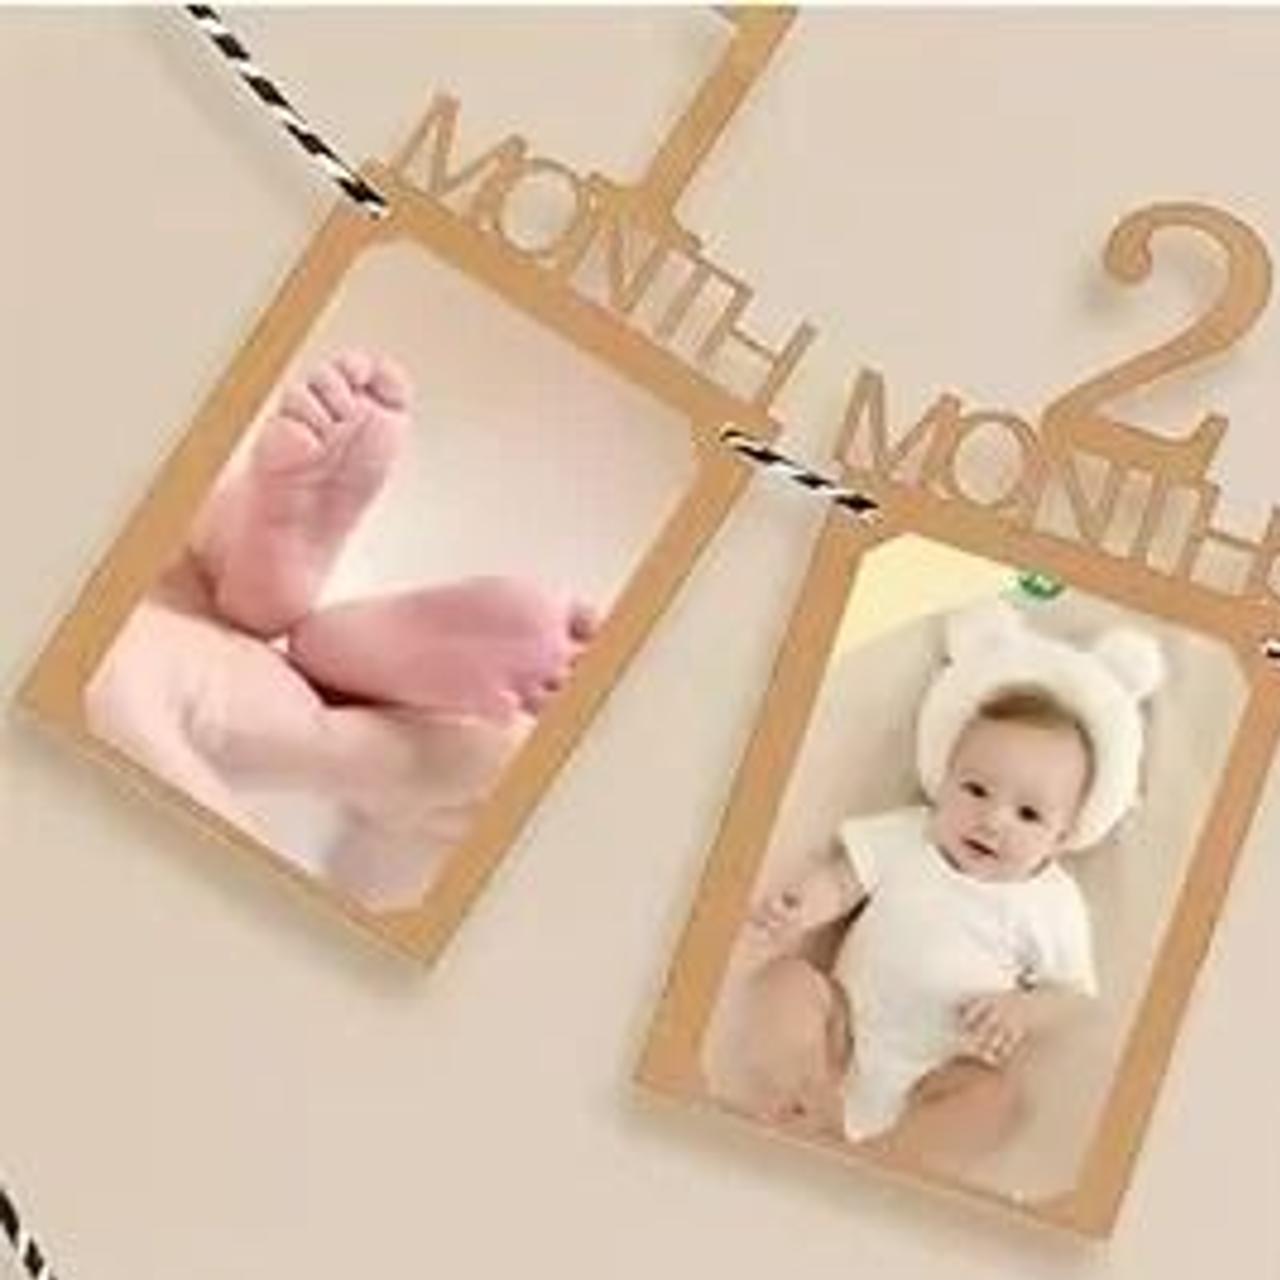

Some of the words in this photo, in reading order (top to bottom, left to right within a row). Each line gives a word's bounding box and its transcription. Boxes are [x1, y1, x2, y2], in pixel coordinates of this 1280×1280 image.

[398, 93, 818, 412] MONTH
[592, 4, 799, 248] 1
[1043, 201, 1273, 472] 2
